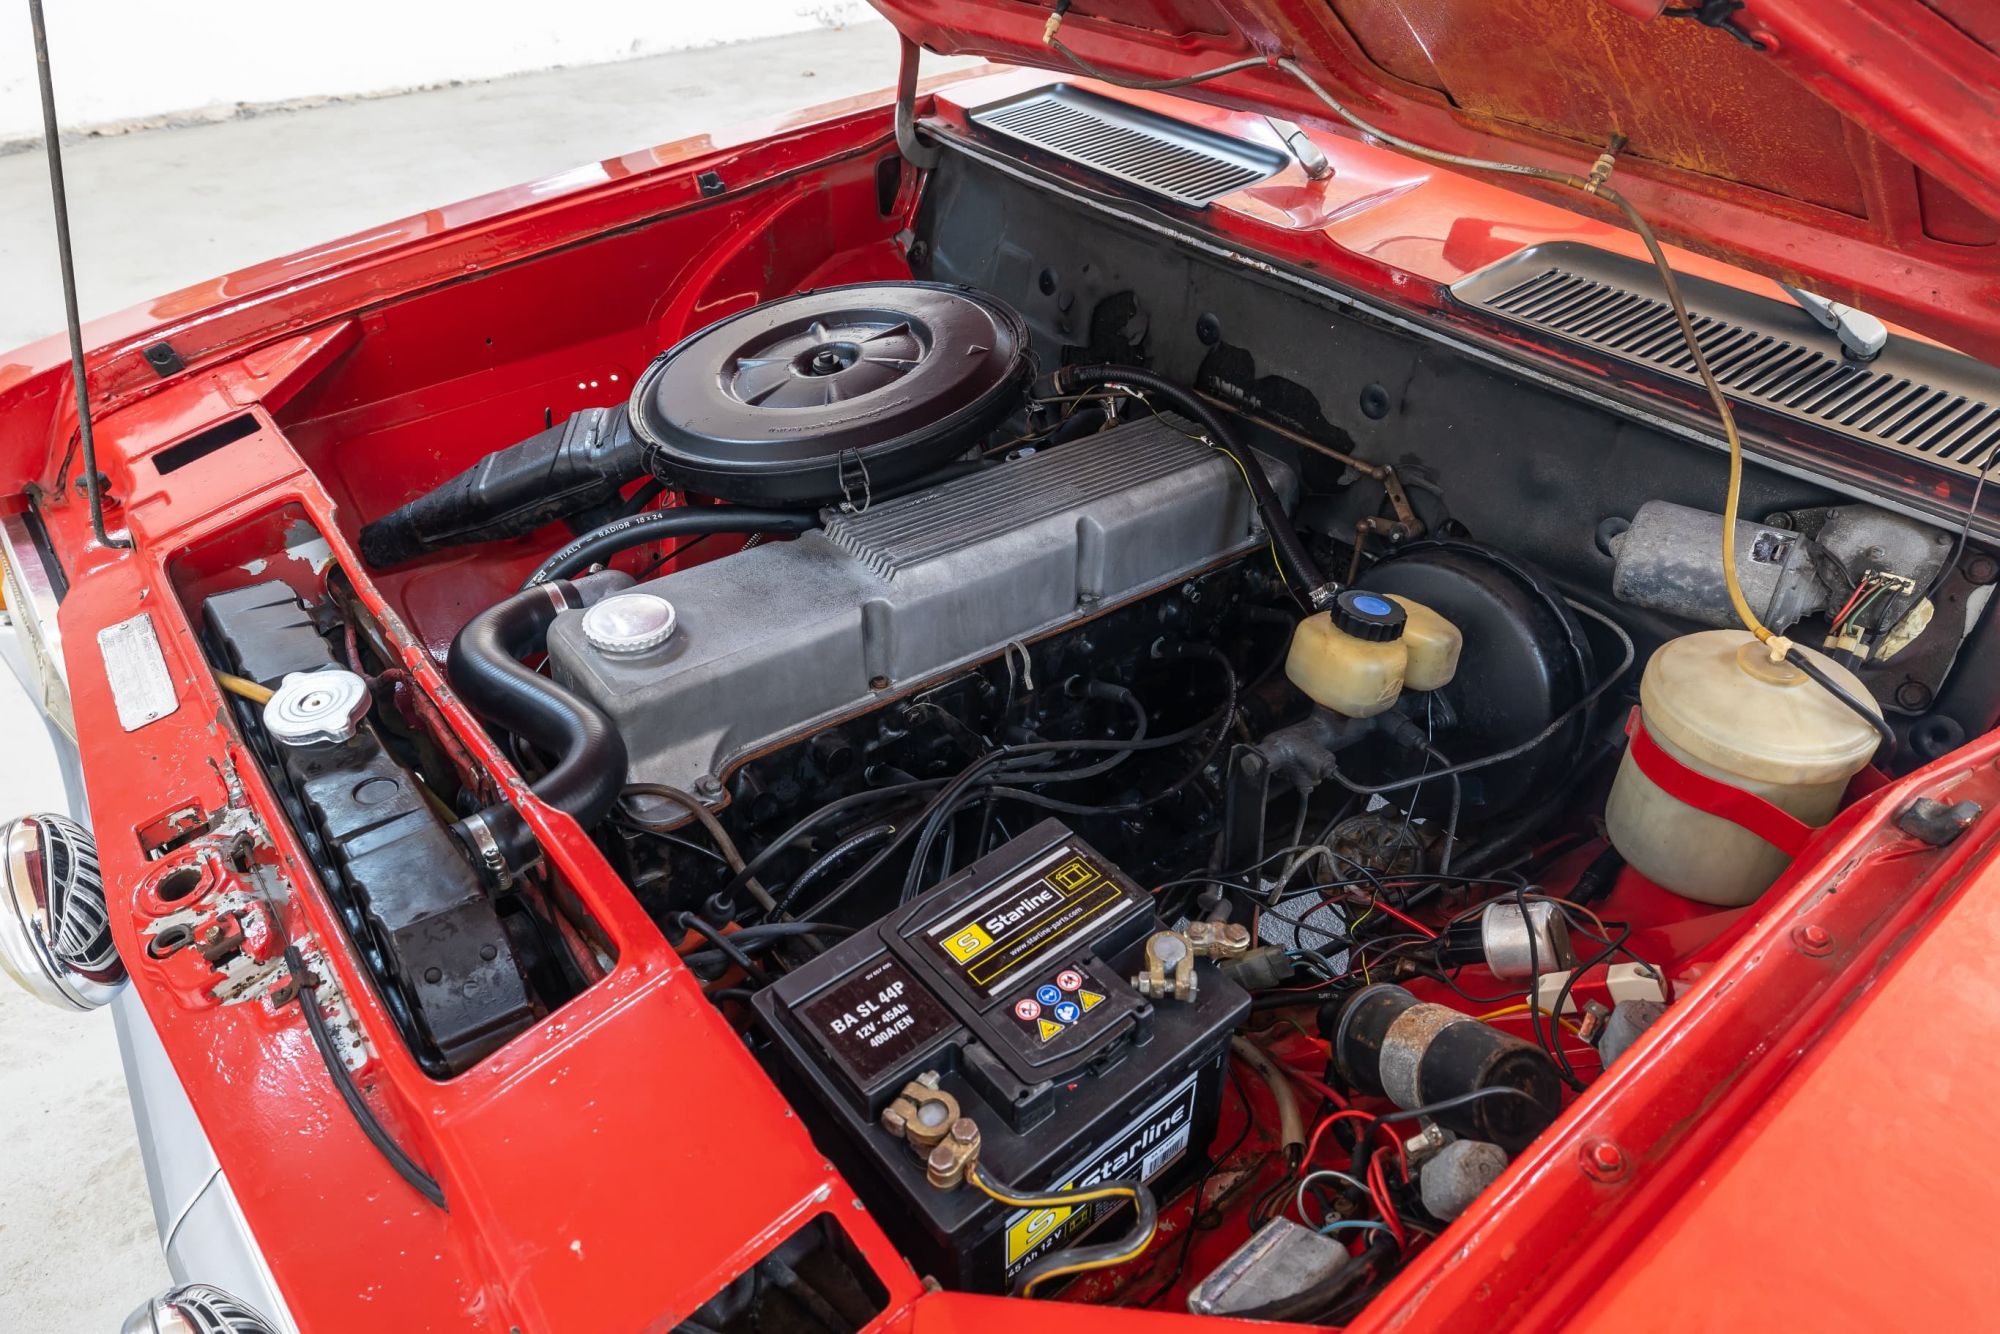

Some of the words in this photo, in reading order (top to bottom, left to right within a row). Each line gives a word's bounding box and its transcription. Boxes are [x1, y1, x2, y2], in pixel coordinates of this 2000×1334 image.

[559, 542, 582, 561] ITALY
[598, 521, 631, 538] RADIOR
[956, 931, 982, 954] S
[985, 889, 1053, 935] Starline
[1009, 906, 1083, 956] www.starline-parts.com
[830, 1012, 859, 1034] BA
[856, 1000, 880, 1018] SL
[878, 981, 904, 1003] 44P
[856, 1021, 876, 1039] 12V
[881, 1003, 909, 1023] 45Ah
[869, 1015, 915, 1047] 400A/EN
[1080, 1104, 1185, 1188] Starline
[1054, 1229, 1062, 1239] V
